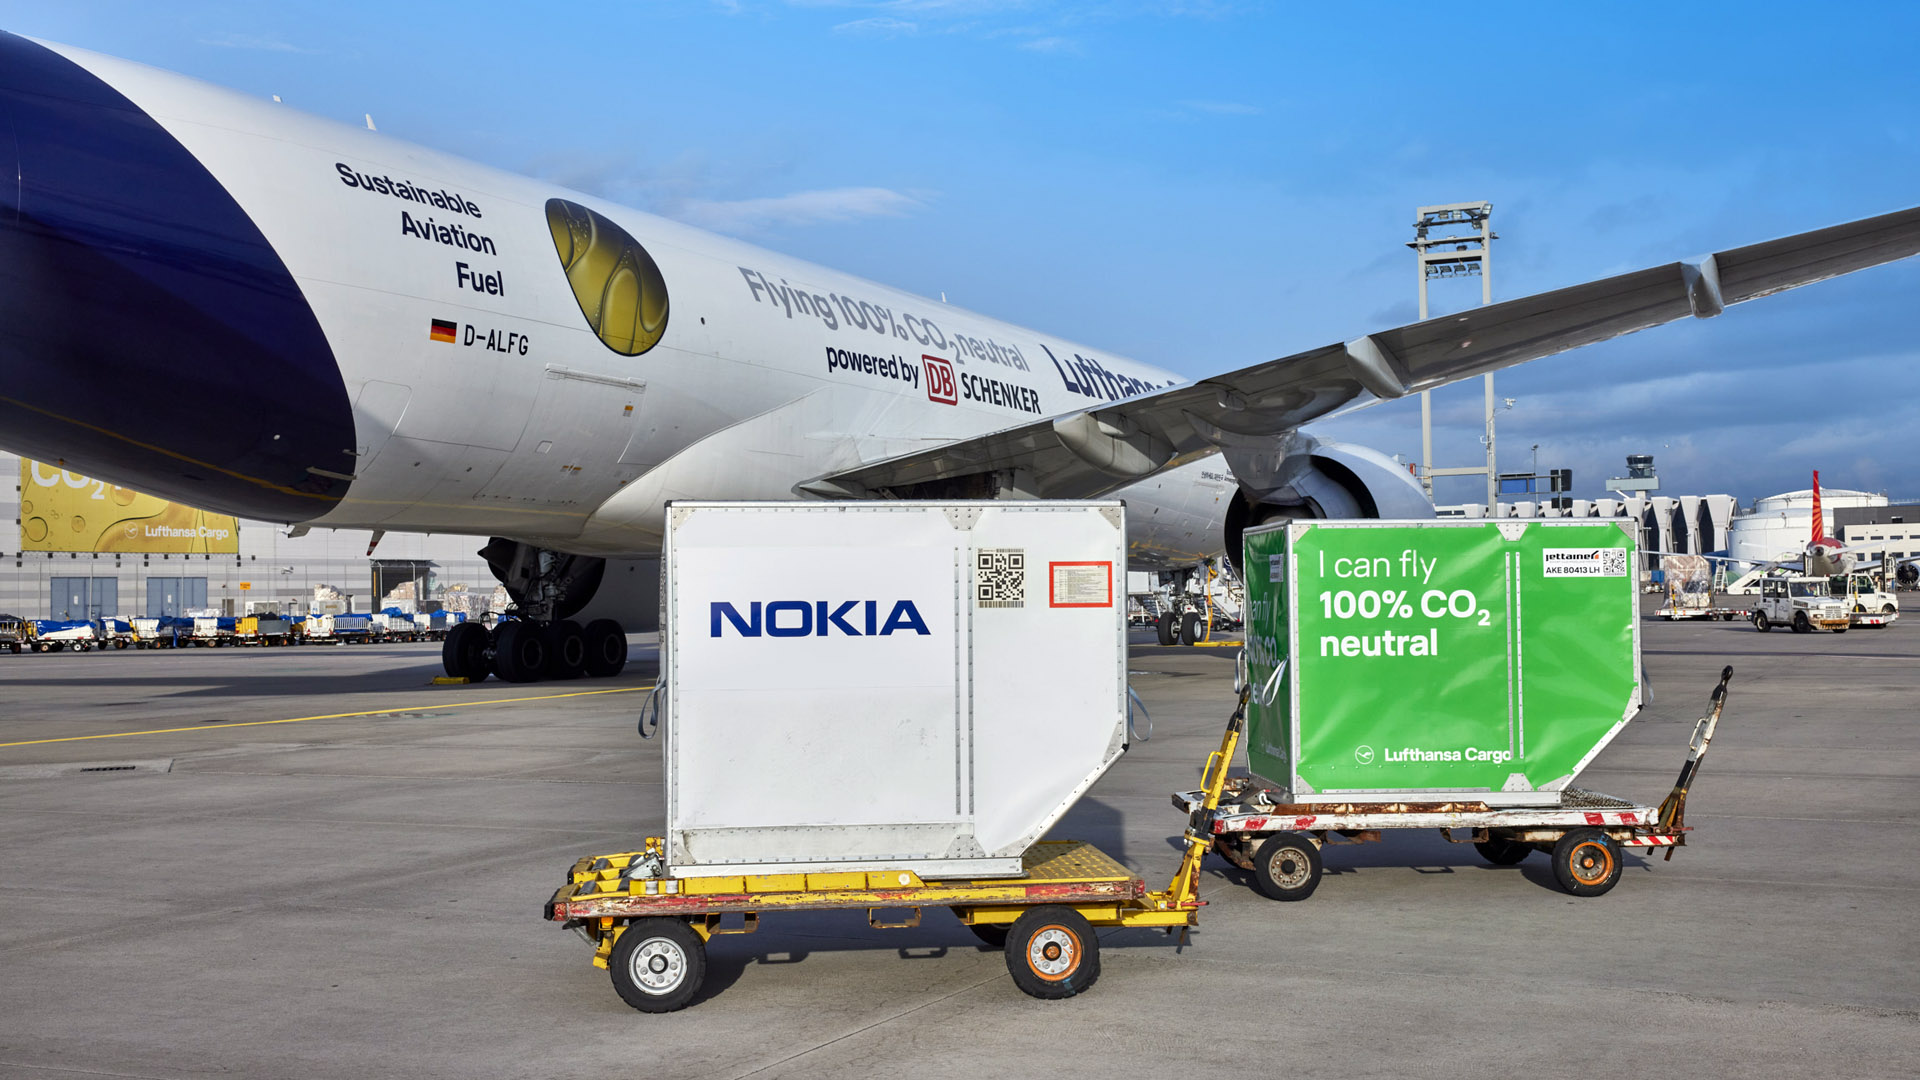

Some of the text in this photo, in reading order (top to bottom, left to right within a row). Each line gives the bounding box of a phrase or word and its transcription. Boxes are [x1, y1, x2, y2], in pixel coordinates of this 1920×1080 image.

[335, 162, 482, 219] Sustainable
[401, 210, 497, 256] Aviation
[455, 261, 505, 297] Fuel
[737, 266, 839, 331] Flying
[829, 292, 909, 341] 100%
[953, 333, 1031, 372] neutral
[463, 324, 529, 356] D-ALFG
[825, 346, 1042, 415] powered by DB SCHENKER
[1040, 343, 1162, 401] Lufthan
[144, 525, 229, 541] Lufthansa Cargo
[1319, 549, 1437, 585] I can fly
[1545, 550, 1600, 562] jettainer
[1545, 566, 1601, 574] AKE 80413 LH
[709, 600, 931, 638] NOKIA
[1319, 589, 1414, 619] 100%
[1320, 628, 1438, 657] neutral
[1384, 747, 1513, 764] Lufthansa Cargo
